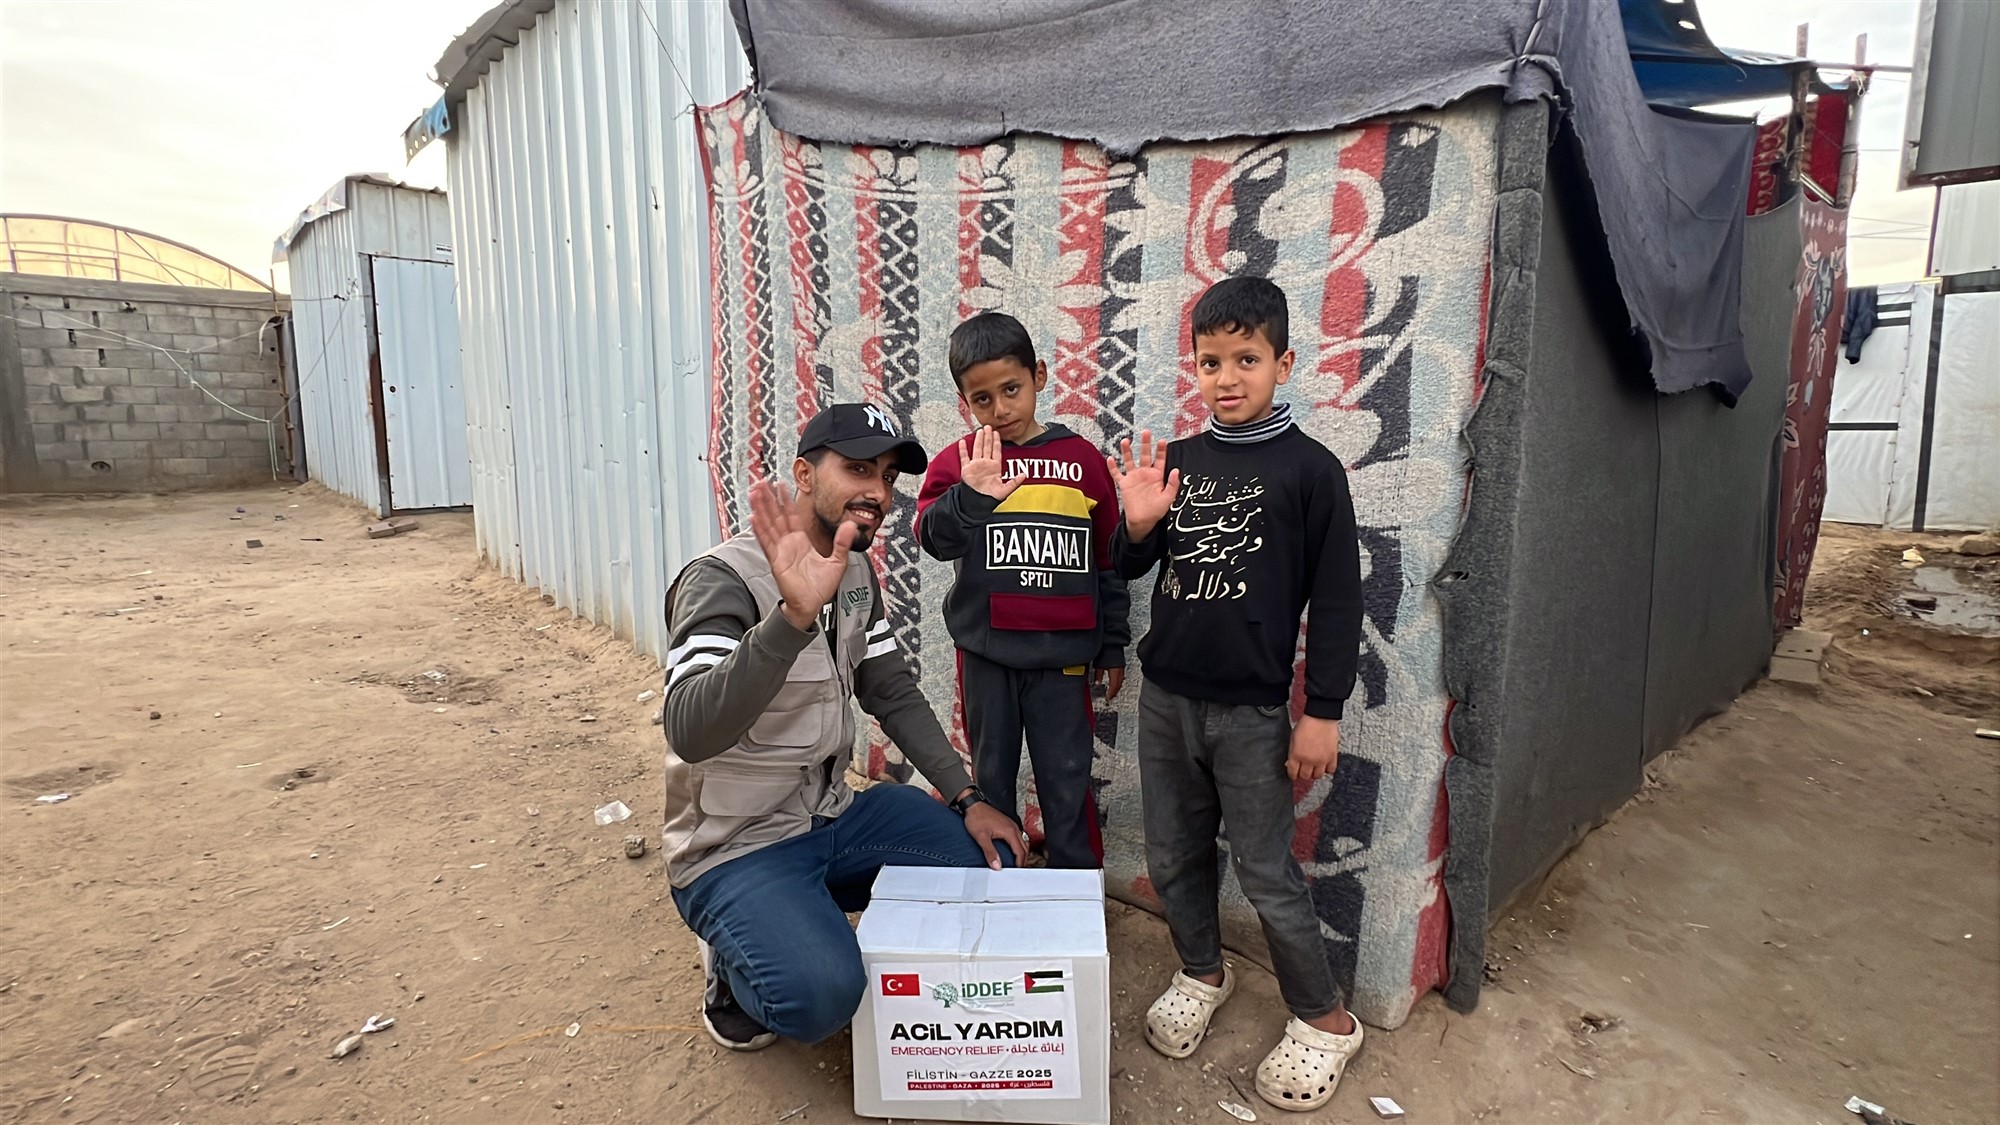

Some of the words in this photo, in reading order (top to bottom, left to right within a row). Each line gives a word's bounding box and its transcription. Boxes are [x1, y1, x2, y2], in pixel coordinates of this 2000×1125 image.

[993, 528, 1081, 567] BANANA
[1020, 570, 1053, 588] SPTLI
[955, 1020, 1063, 1040] YARDIM
[891, 1046, 963, 1056] EMERGENCY
[965, 1045, 1004, 1055] RELIEF
[969, 1069, 1013, 1079] GAZZE
[1016, 1068, 1052, 1078] 2025
